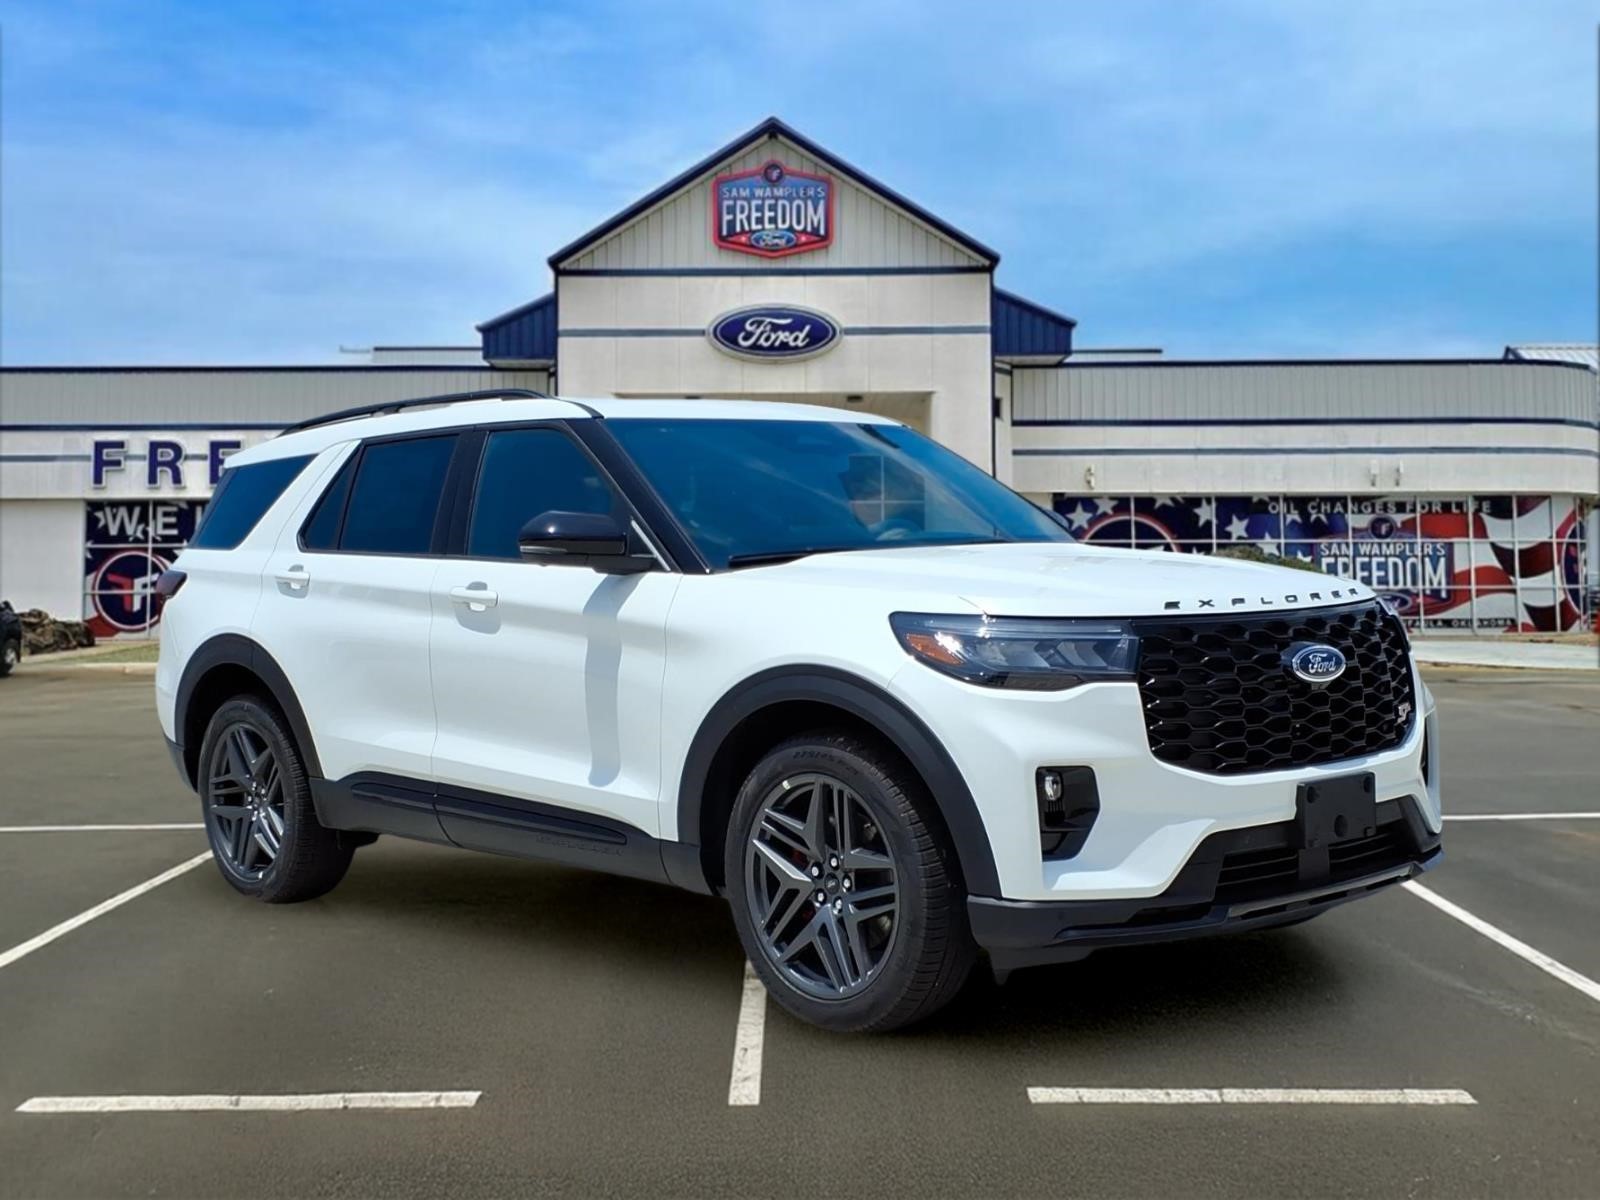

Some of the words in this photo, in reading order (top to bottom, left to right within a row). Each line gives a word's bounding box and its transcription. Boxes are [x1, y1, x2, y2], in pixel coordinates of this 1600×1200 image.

[722, 187, 750, 198] SAM
[722, 200, 825, 236] FREEDOM
[759, 232, 787, 247] Ford
[737, 316, 812, 348] Ford
[1268, 501, 1299, 514] OIL
[1307, 500, 1397, 514] CHANGES
[1406, 500, 1443, 514] FOR
[1451, 500, 1492, 514] LIFE
[1164, 587, 1359, 610] EXPLORER
[1307, 653, 1337, 673] Ford
